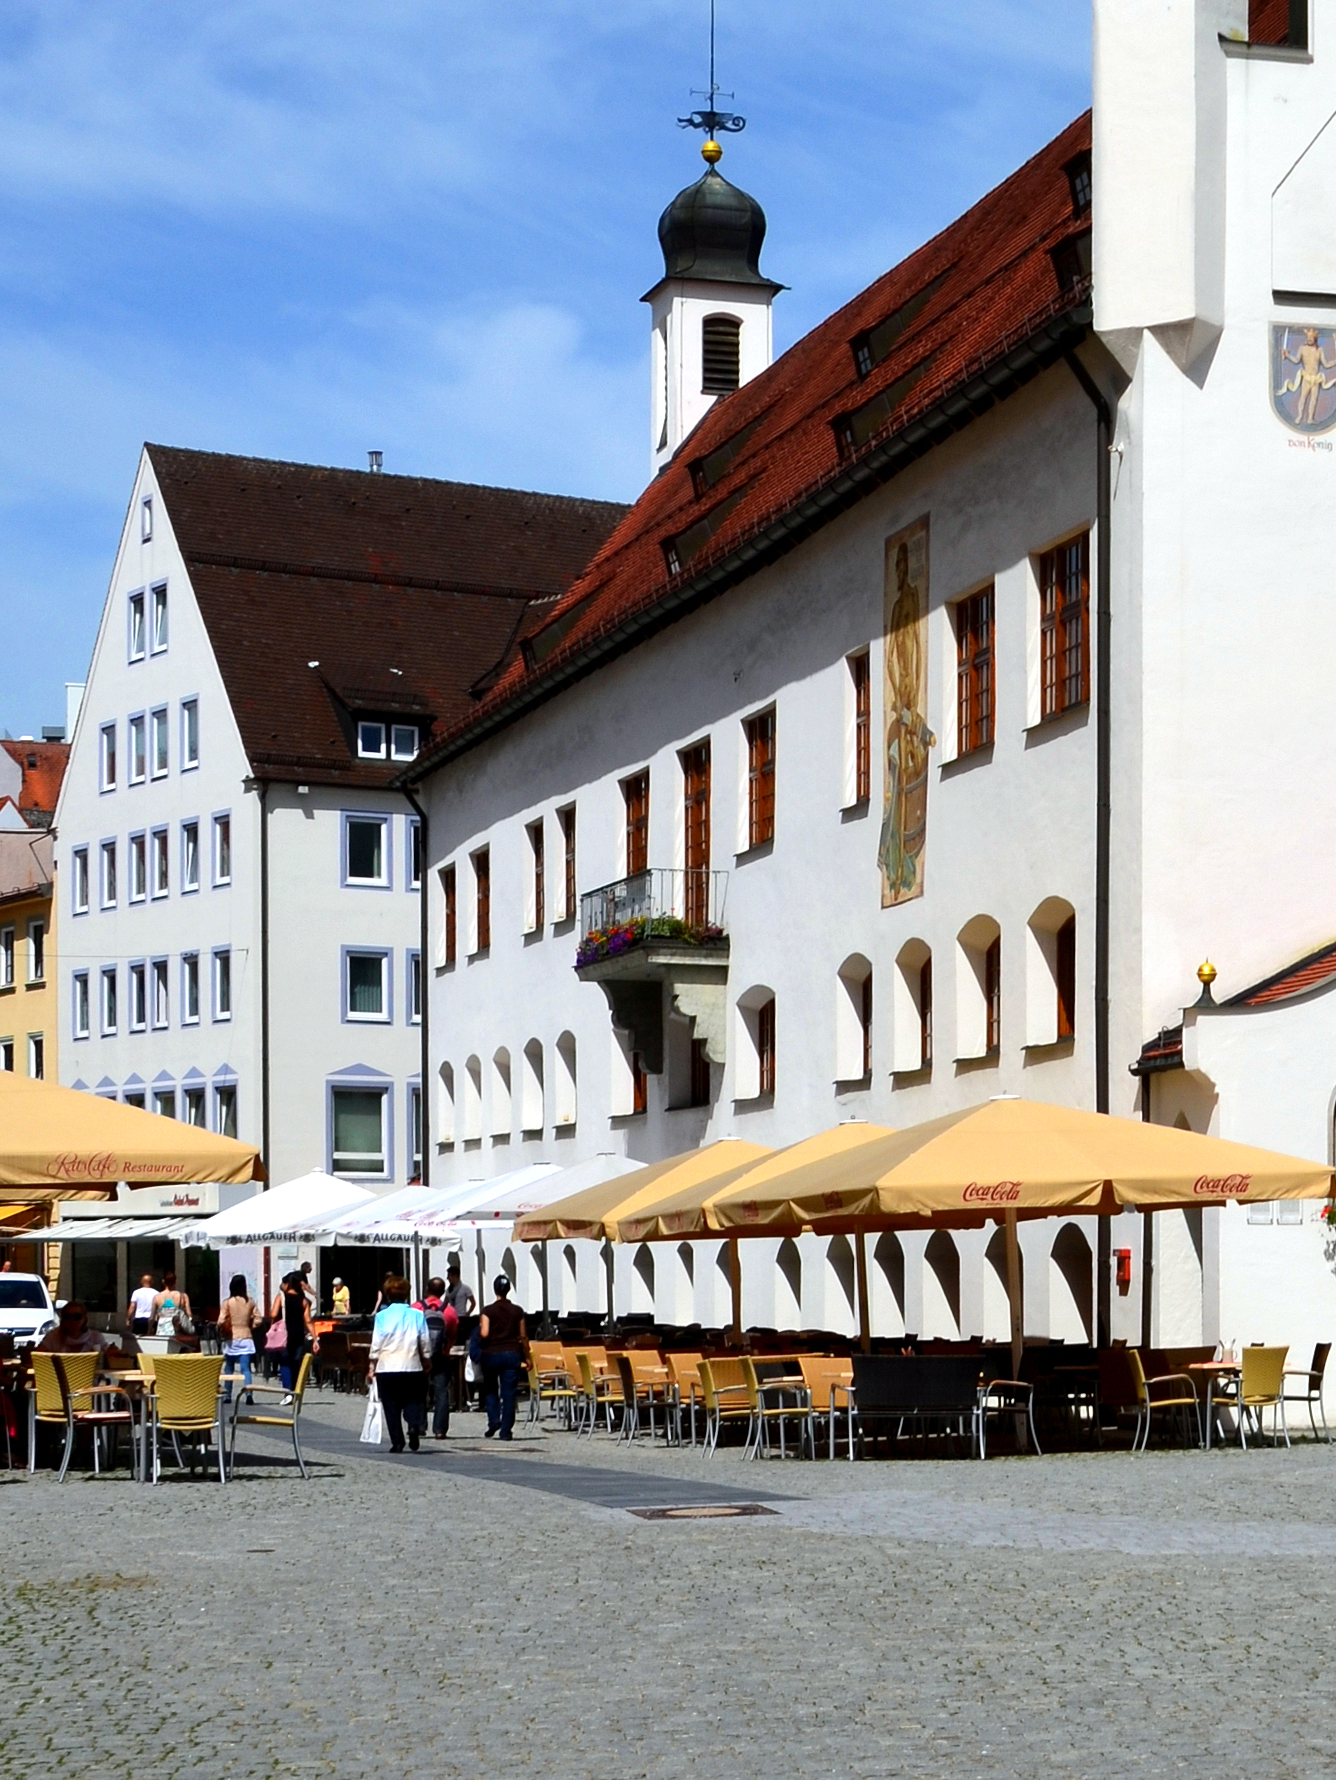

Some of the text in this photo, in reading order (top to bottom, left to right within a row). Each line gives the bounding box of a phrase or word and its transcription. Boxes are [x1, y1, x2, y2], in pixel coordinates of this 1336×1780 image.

[122, 1161, 185, 1174] Restaurant
[962, 1180, 1024, 1202] Coca-Cola
[1193, 1173, 1253, 1195] Coca-Cola
